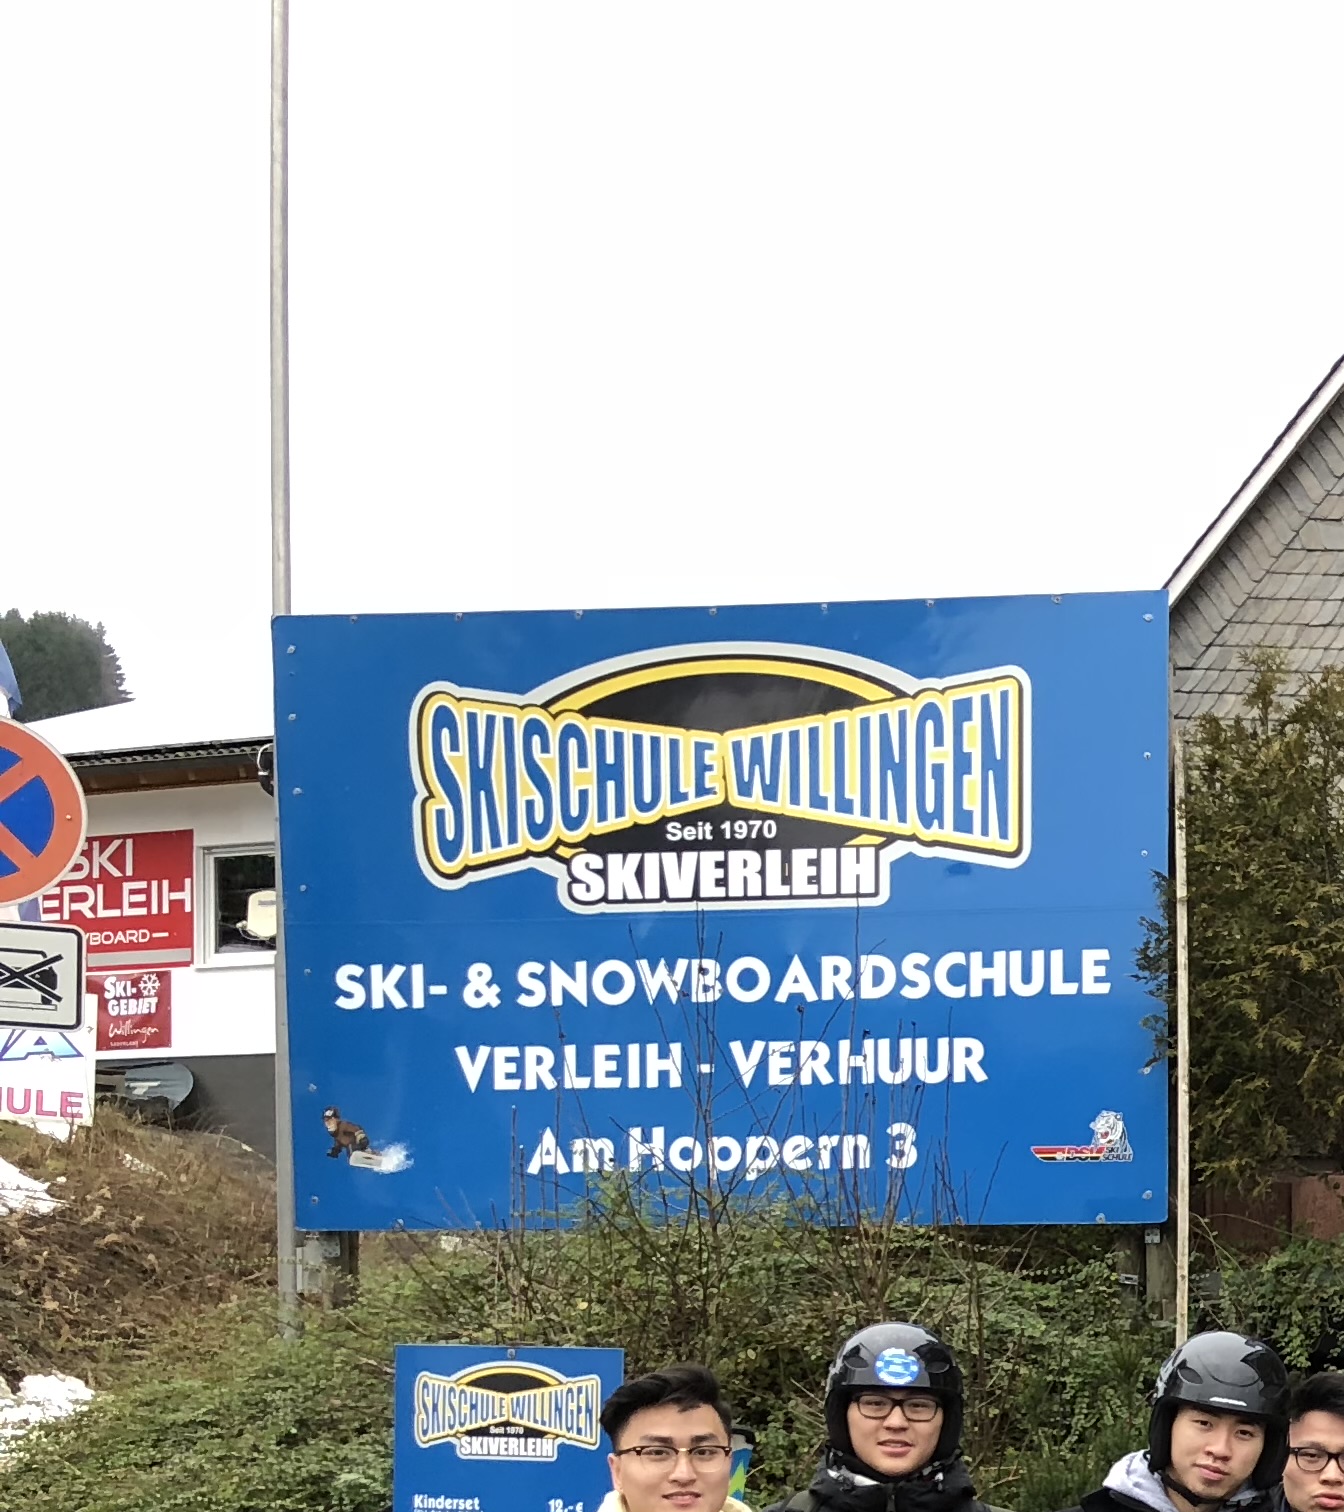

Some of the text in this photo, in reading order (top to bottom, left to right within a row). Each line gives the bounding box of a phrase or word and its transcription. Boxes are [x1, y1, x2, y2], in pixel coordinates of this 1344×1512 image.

[429, 688, 1011, 866] SKISCHULE WILLINGEN
[665, 819, 777, 841] Seit 1970
[61, 838, 134, 881] SKI
[572, 847, 876, 901] SKIVERLEIH
[40, 878, 192, 921] ERLEIH
[85, 929, 150, 945] BOARD
[334, 949, 1111, 1011] SKI- & SNOWBOARDSCHULE
[108, 996, 159, 1016] GEBIET
[109, 1021, 160, 1044] Willingen
[455, 1041, 684, 1093] VERLEIH
[729, 1036, 988, 1089] VERHUUR
[0, 1087, 84, 1118] ULE
[528, 1122, 917, 1181] Am Hoppern 3
[421, 1379, 595, 1440] SKISCHULE WILLINGEN
[460, 1436, 554, 1457] SKIVERLEIH
[413, 1494, 480, 1510] Kinderset
